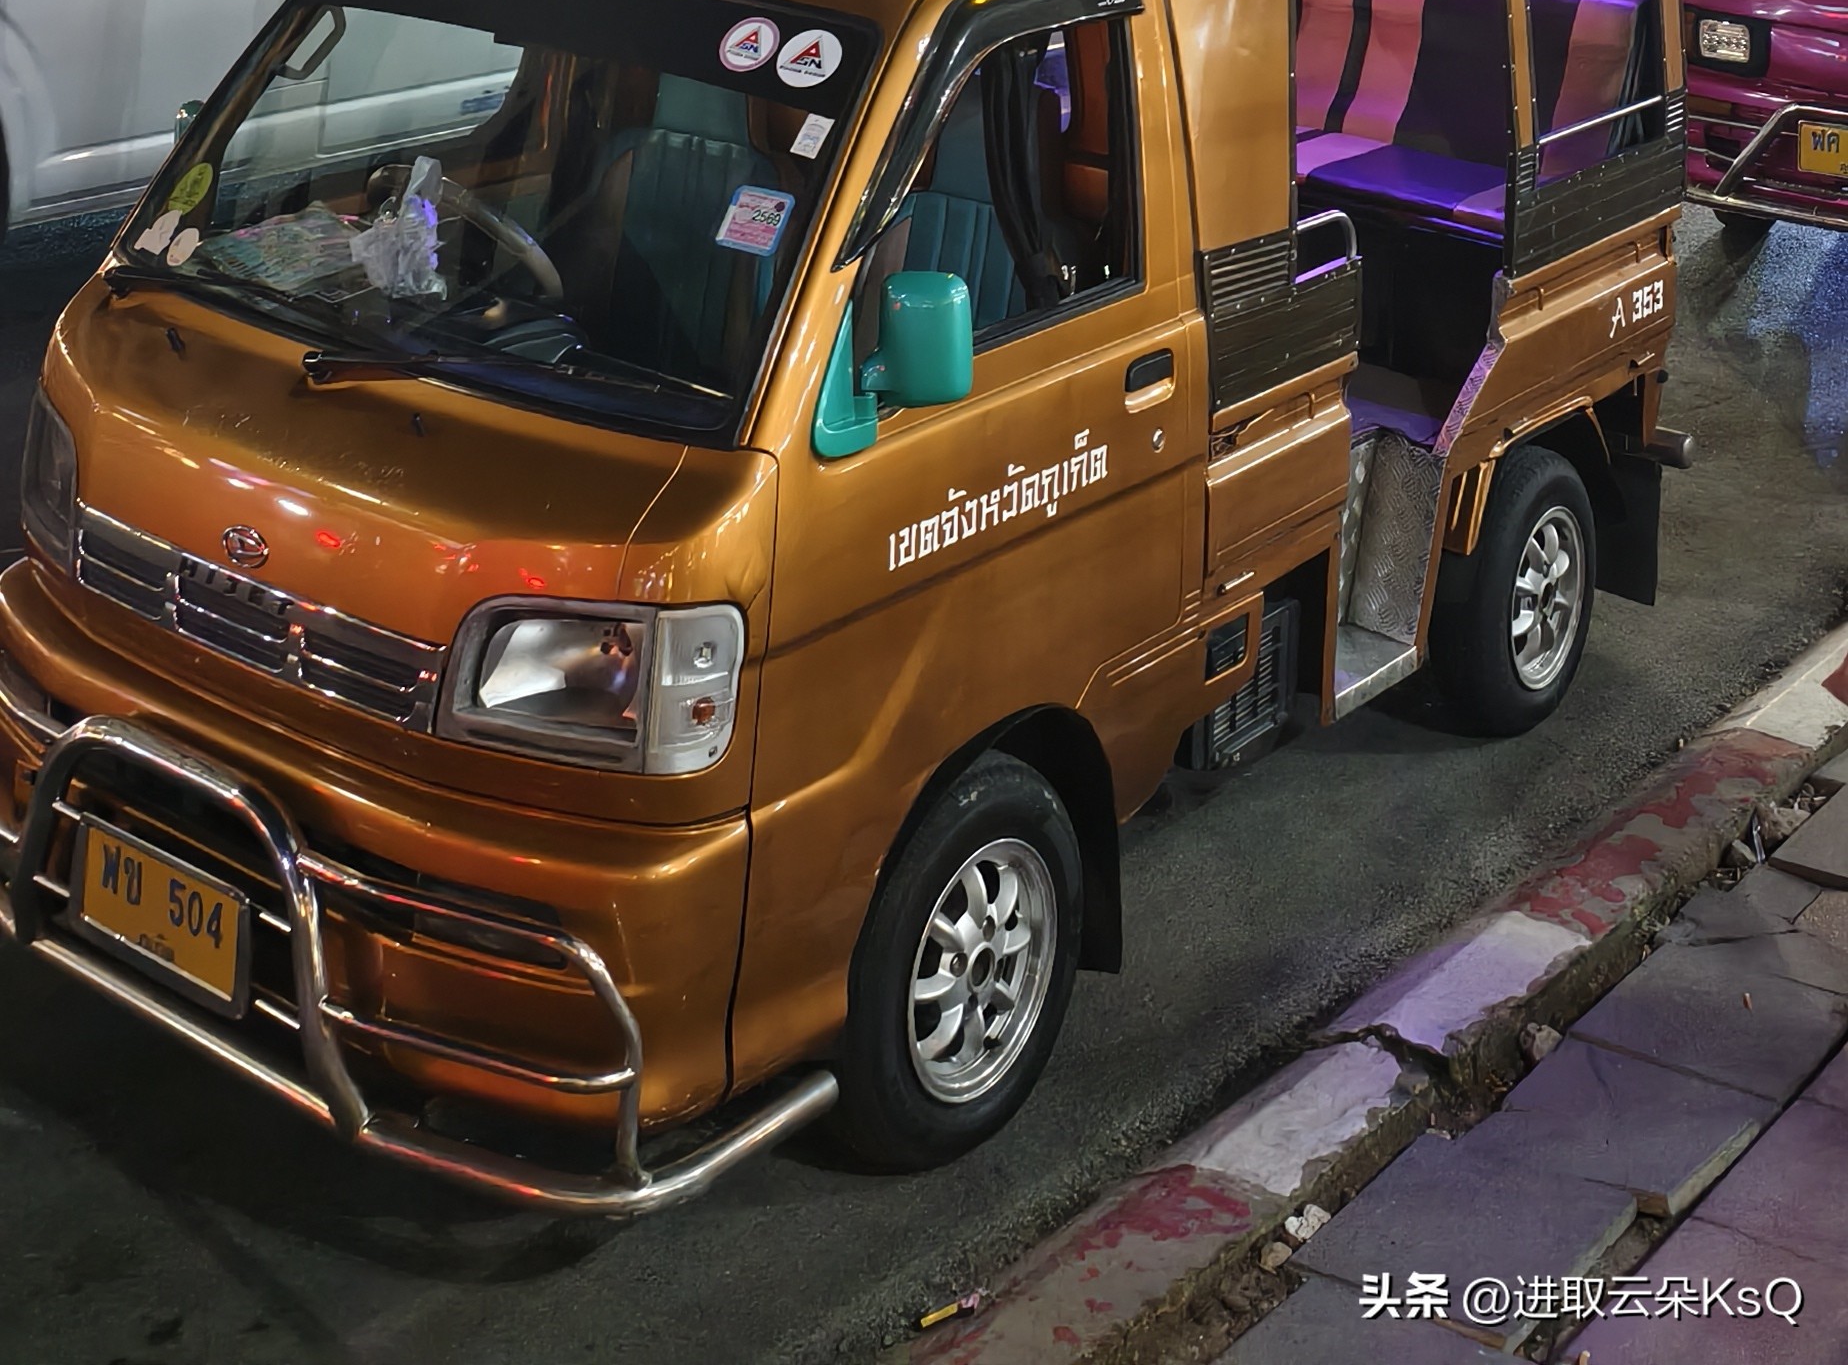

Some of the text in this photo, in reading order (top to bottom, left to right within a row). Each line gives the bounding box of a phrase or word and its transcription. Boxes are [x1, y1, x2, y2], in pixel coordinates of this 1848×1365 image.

[1609, 279, 1664, 338] A 353
[168, 878, 223, 949] 504
